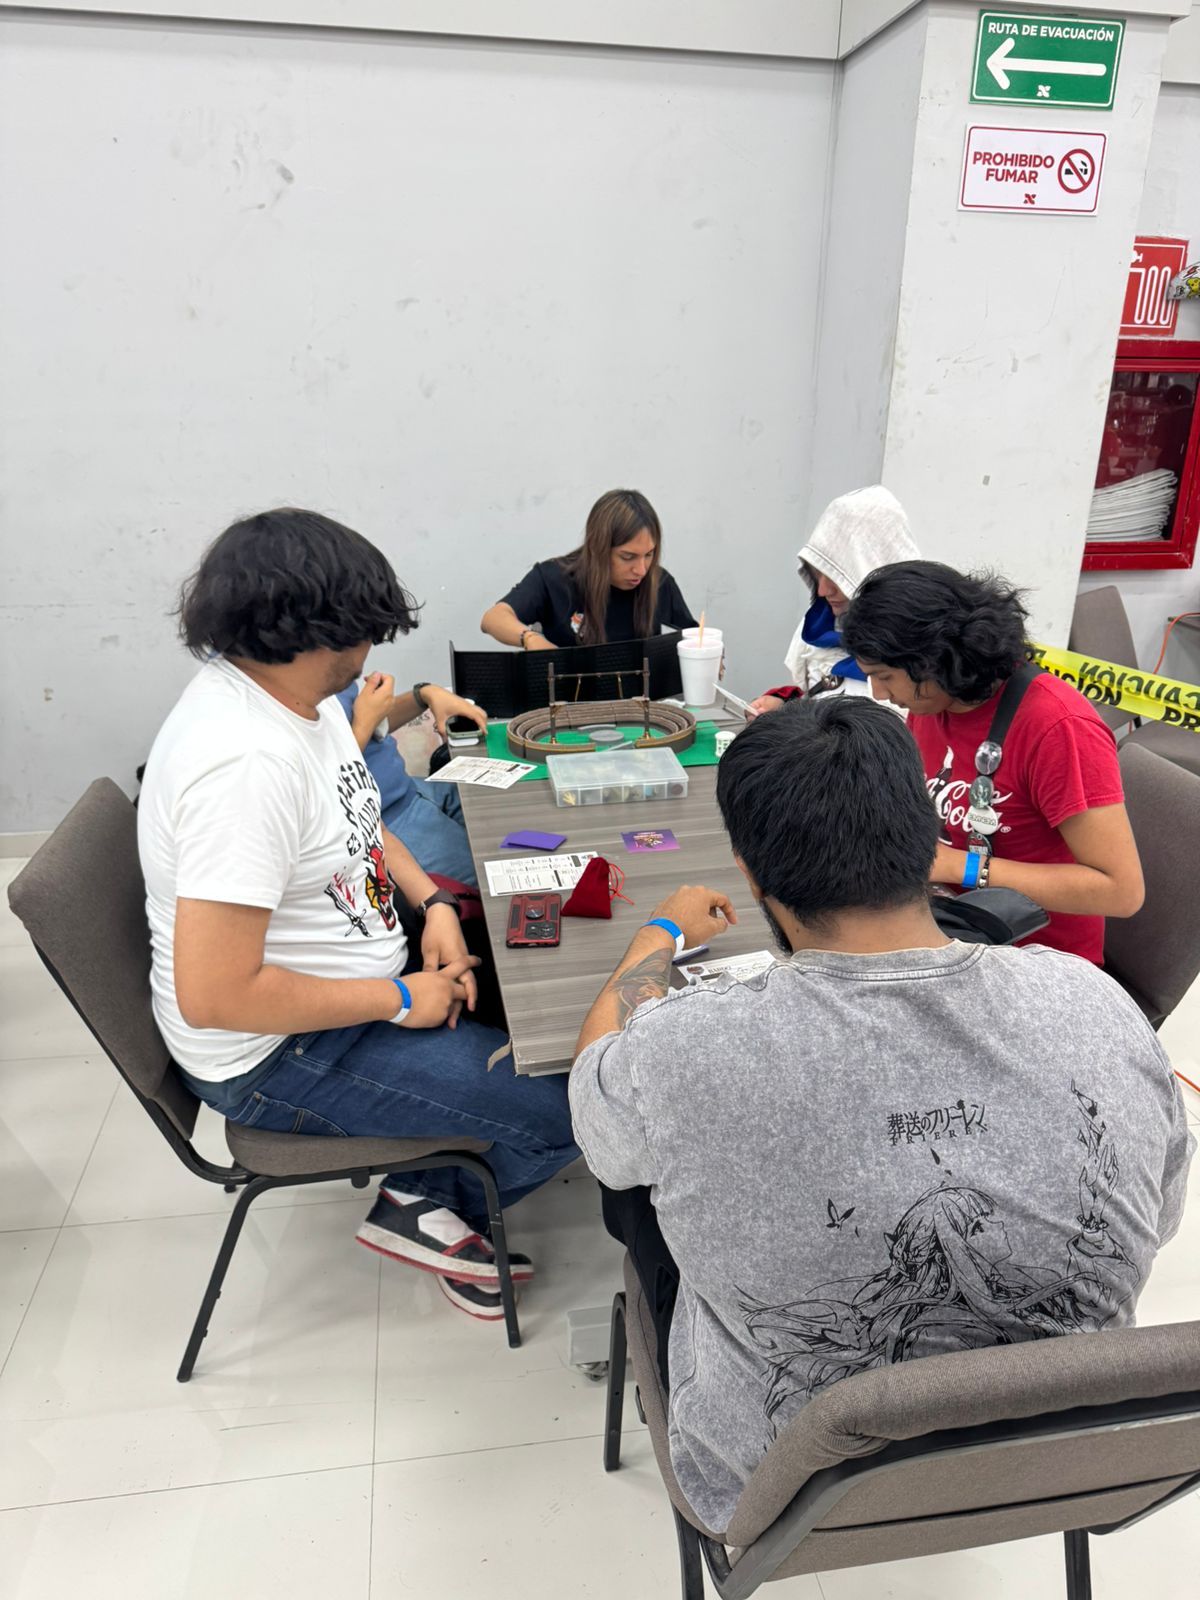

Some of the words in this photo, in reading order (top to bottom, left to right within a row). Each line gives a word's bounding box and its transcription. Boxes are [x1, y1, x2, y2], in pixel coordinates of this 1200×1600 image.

[987, 22, 1020, 36] RUTA
[1021, 25, 1038, 37] DE
[1040, 25, 1114, 42] EVACUACIÓN
[972, 151, 1055, 169] PROHIBIDO
[985, 168, 1038, 184] FUMAR
[887, 1103, 988, 1139] 葬送のフリーレン
